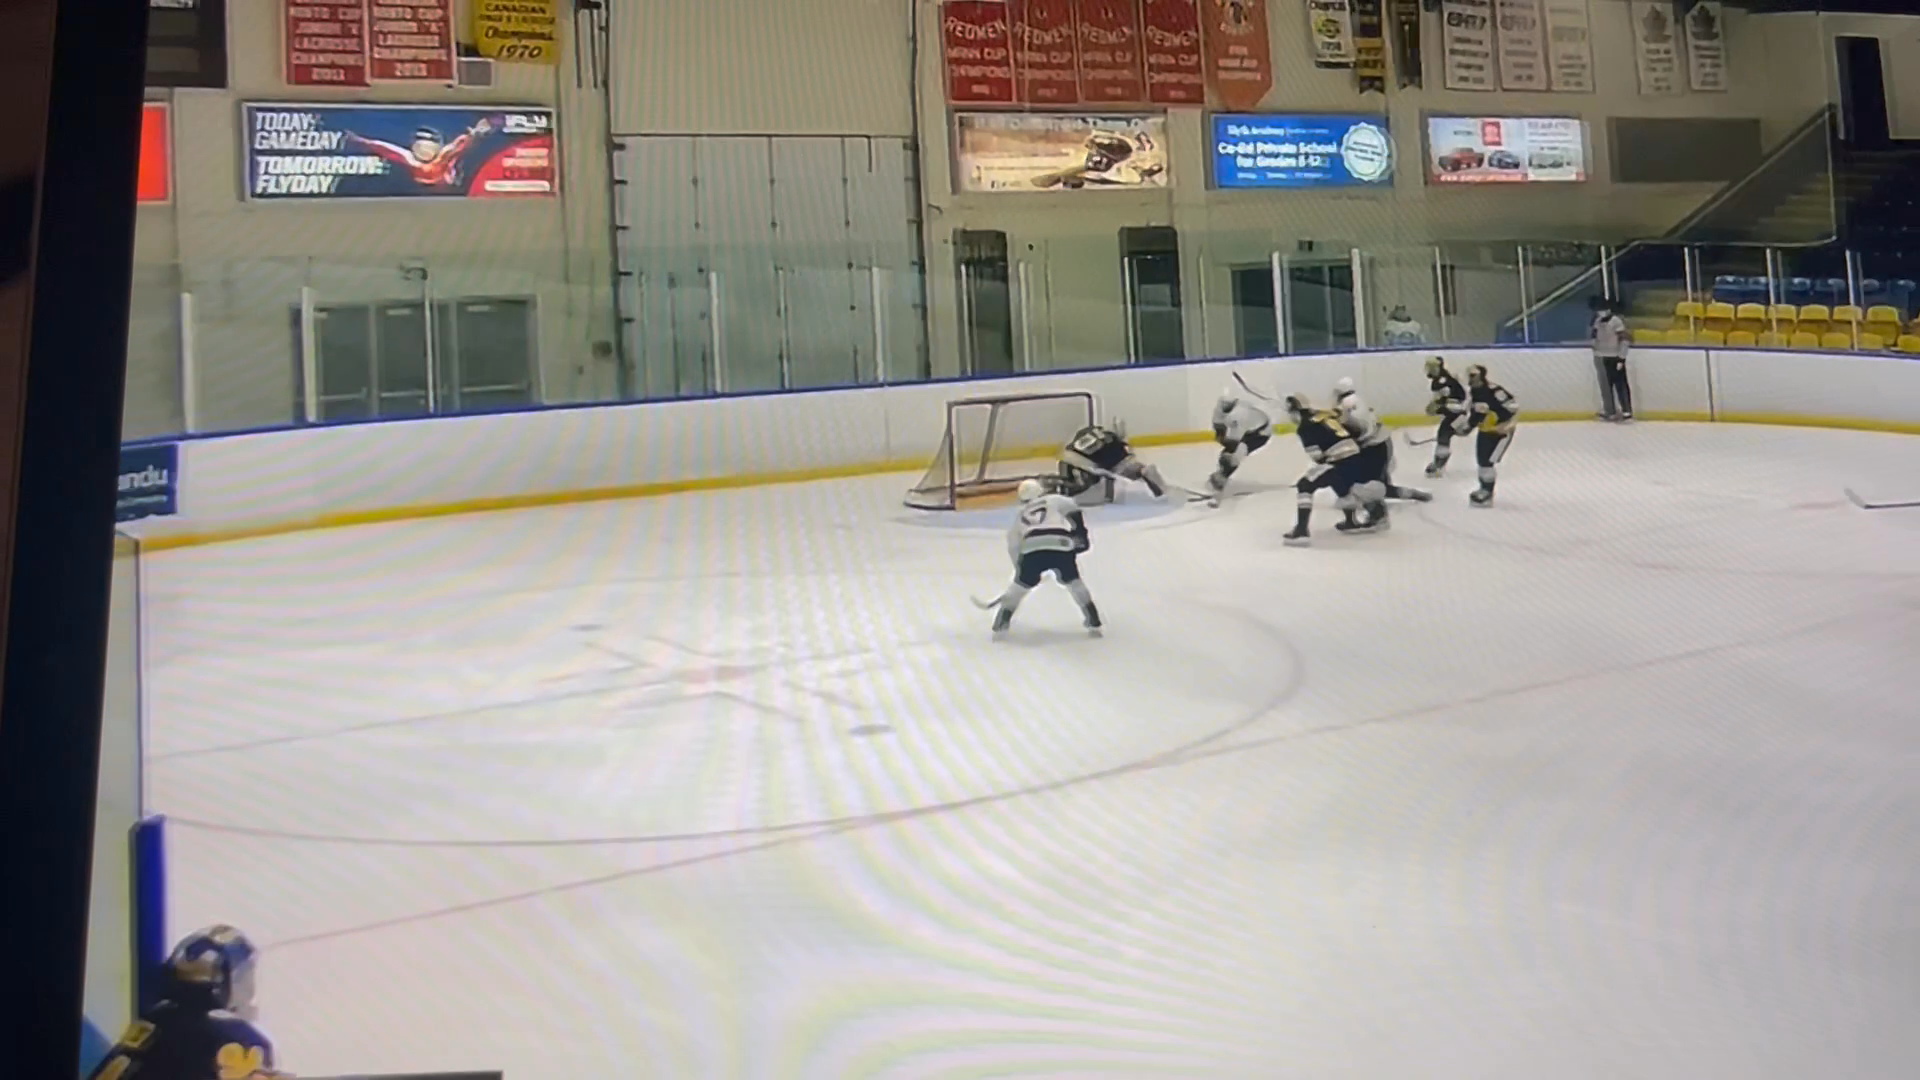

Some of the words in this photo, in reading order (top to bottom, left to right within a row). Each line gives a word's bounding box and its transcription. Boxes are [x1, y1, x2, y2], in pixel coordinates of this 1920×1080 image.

[485, 3, 546, 14] CANADIAN
[945, 16, 1006, 39] REDMEN
[1014, 21, 1074, 45] REDMEN
[498, 45, 542, 58] 1970
[983, 47, 1007, 60] CUP
[254, 131, 343, 150] GAMEDAY
[256, 175, 334, 194] FLYDAY
